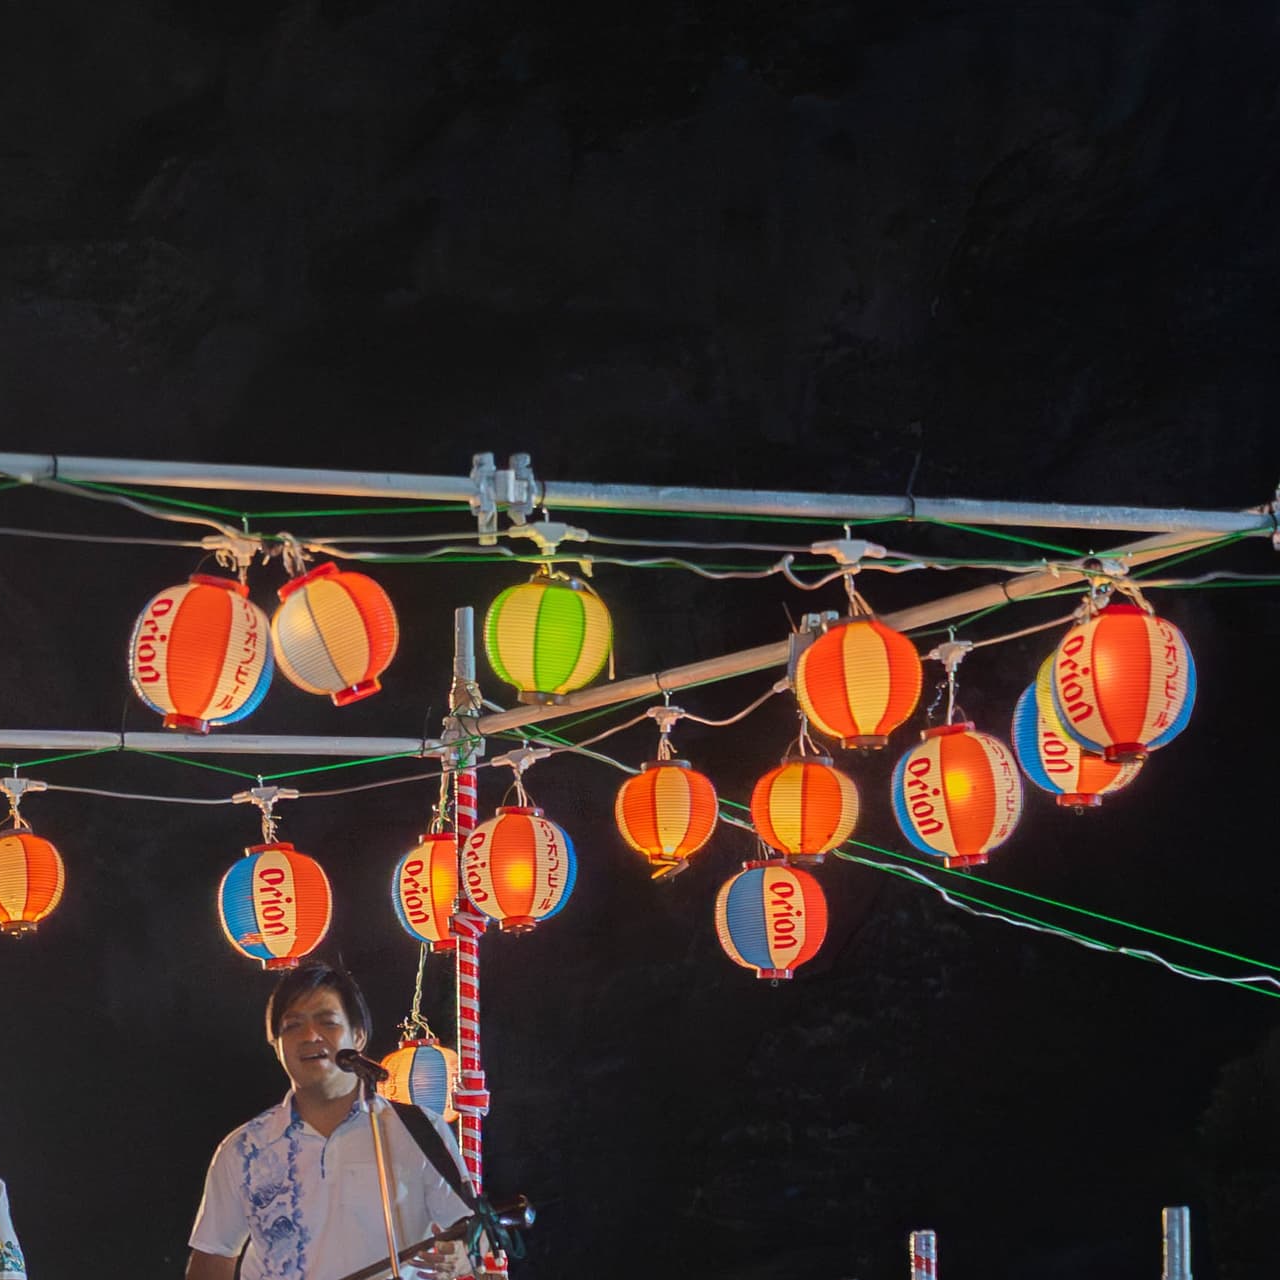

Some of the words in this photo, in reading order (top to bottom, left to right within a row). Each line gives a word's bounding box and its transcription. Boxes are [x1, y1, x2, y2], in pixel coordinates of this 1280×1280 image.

[138, 598, 173, 682] Orion
[1059, 635, 1093, 723] Orion
[907, 757, 944, 835] Orion
[259, 868, 292, 935] Orion
[403, 860, 429, 924] Orion
[466, 832, 489, 902] Orion
[770, 882, 802, 949] Orion
